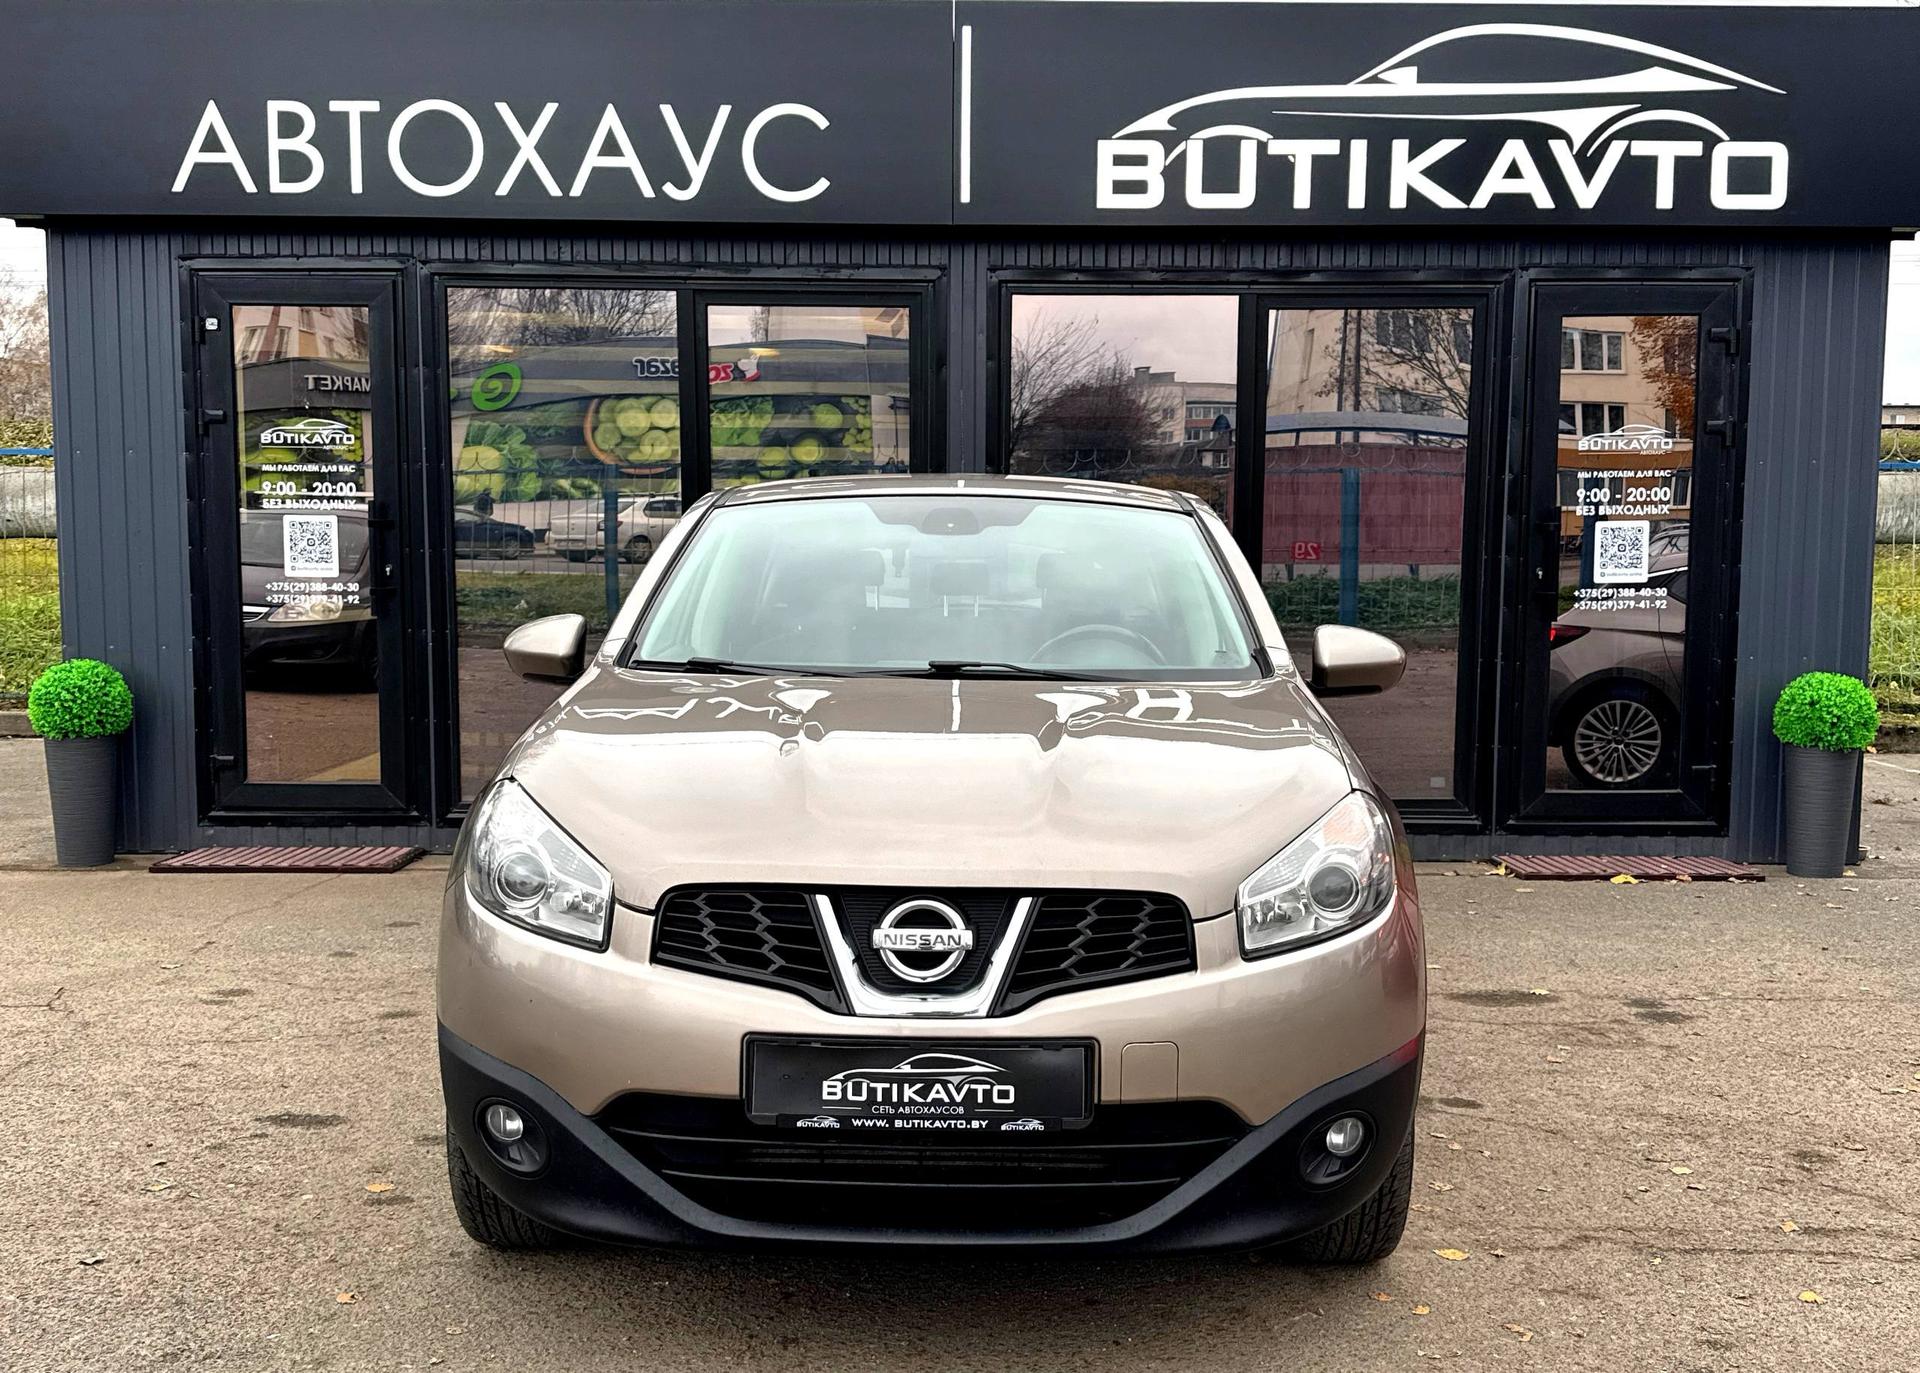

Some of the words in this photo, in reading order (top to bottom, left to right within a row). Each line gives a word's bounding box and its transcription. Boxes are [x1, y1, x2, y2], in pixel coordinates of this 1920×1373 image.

[172, 99, 831, 203] АВТОХАУС
[1096, 139, 1789, 209] BUTIKAVTO
[261, 433, 354, 444] BUTIKAVTO
[1578, 439, 1672, 450] BUTIKAVTO
[262, 464, 277, 472] МЫ
[278, 464, 320, 472] РАБОТАЕМ
[321, 465, 338, 473] ДЛЯ
[339, 465, 356, 473] ВАС
[1593, 470, 1635, 478] РАБОТАЕМ
[1636, 470, 1653, 478] ДЛЯ
[262, 481, 296, 496] 9:00
[313, 482, 357, 497] 20:00
[1576, 488, 1610, 503] 9:00
[1626, 487, 1671, 502] 20:00
[263, 498, 282, 509] БЕЗ
[285, 499, 357, 510] ВЫХОДНЫХ
[1576, 505, 1595, 516] БЕЗ
[1598, 505, 1670, 515] ВЫХОДНЫХ
[266, 582, 359, 593] +375(29)388-40-30
[1573, 587, 1668, 600] +375(29)388-40-30
[1573, 598, 1667, 611] +375(29)379-41-92
[884, 934, 961, 946] NISSAN
[822, 1081, 1015, 1104] BUTIKAVTO
[871, 1105, 896, 1115] СЕТЬ
[898, 1105, 965, 1115] АВТОХАУСОВ
[796, 1120, 840, 1128] BUTIKAVTO
[852, 1118, 889, 1128] WWW.
[895, 1119, 989, 1129] BUTIKAVTO.BY
